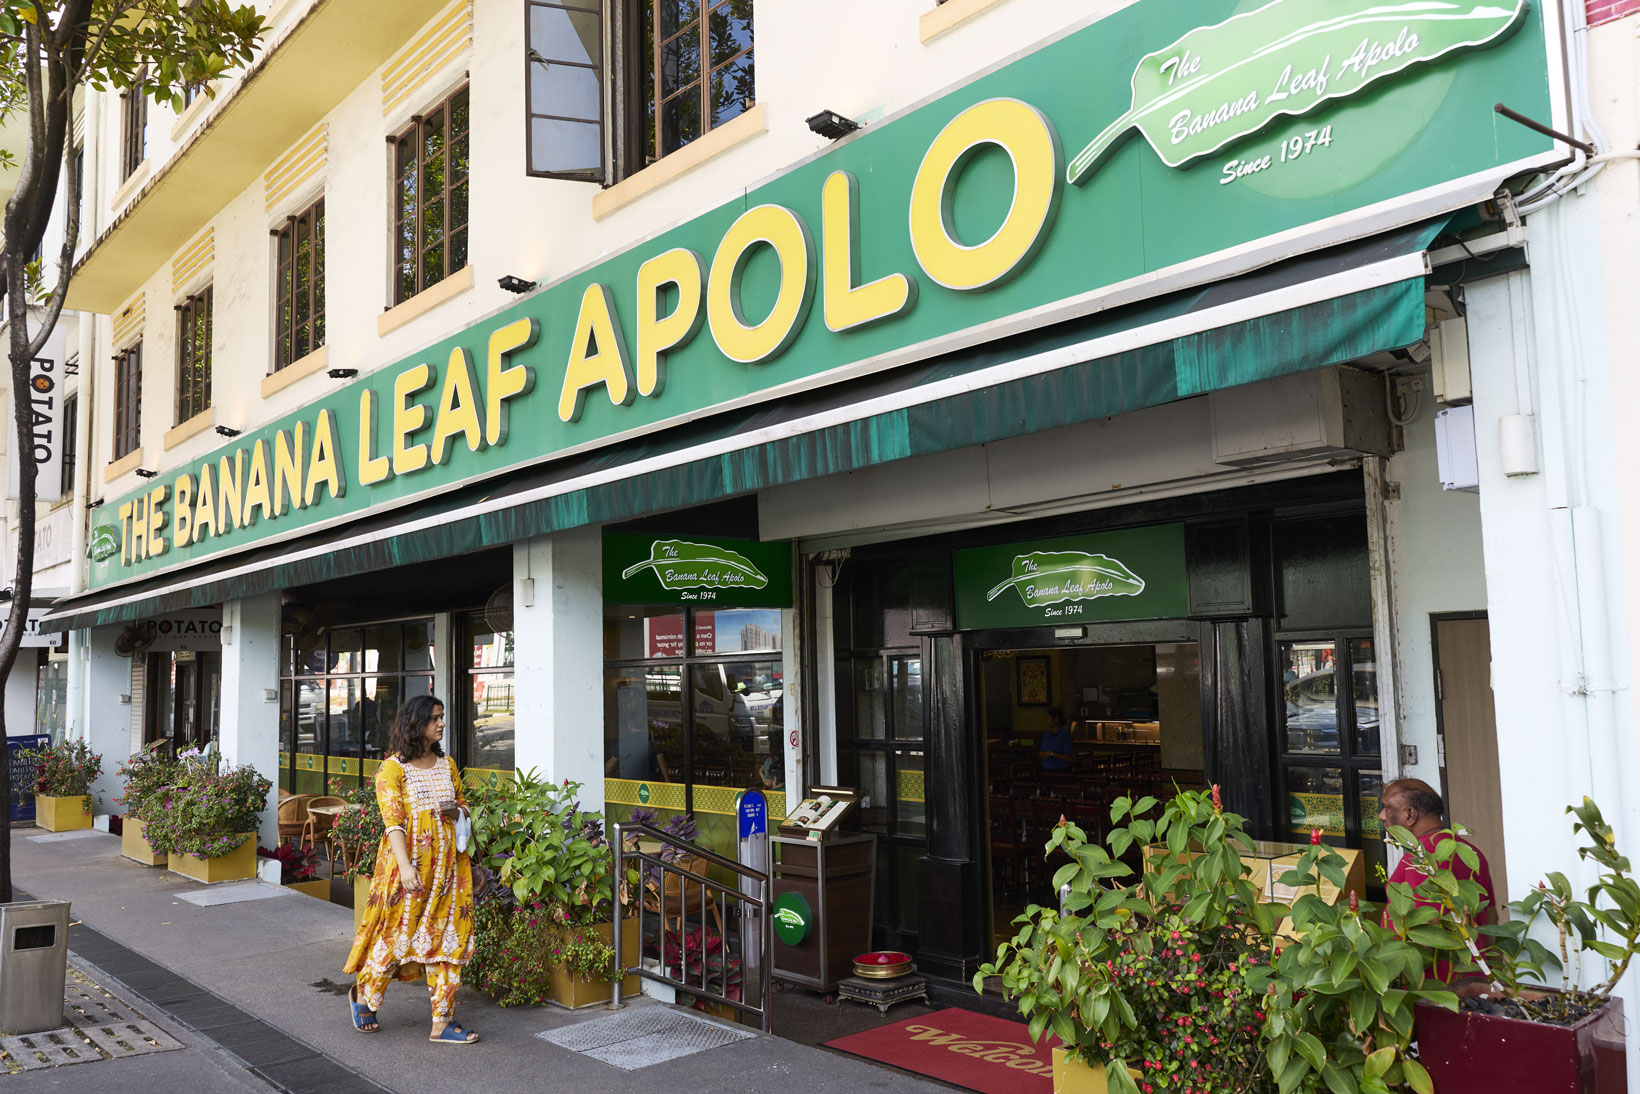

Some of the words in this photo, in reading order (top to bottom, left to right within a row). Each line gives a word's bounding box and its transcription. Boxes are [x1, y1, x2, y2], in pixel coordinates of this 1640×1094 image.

[1160, 50, 1201, 85] The
[1168, 91, 1260, 145] Banana
[1265, 54, 1330, 104] Leaf
[1336, 25, 1421, 80] Apolo
[1219, 154, 1272, 185] Since
[1280, 125, 1333, 162] 1974
[118, 484, 171, 567] THE
[173, 408, 346, 548] BANANA
[358, 317, 538, 486] LEAF
[558, 97, 1063, 423] APOLO
[31, 357, 55, 464] POTATO
[662, 546, 679, 557] The
[665, 569, 698, 582] Banana
[699, 568, 721, 584] Leaf
[721, 570, 745, 584] Apolo
[1021, 559, 1039, 573] The
[680, 591, 698, 600] Since
[699, 591, 717, 600] 1974
[1026, 585, 1060, 599] Banana
[1061, 579, 1085, 595] Leaf
[1086, 578, 1113, 594] Apolo
[1044, 607, 1063, 617] Since
[1065, 605, 1083, 615] 1974
[147, 620, 222, 634] POTATO
[905, 1024, 1054, 1078] Welco
